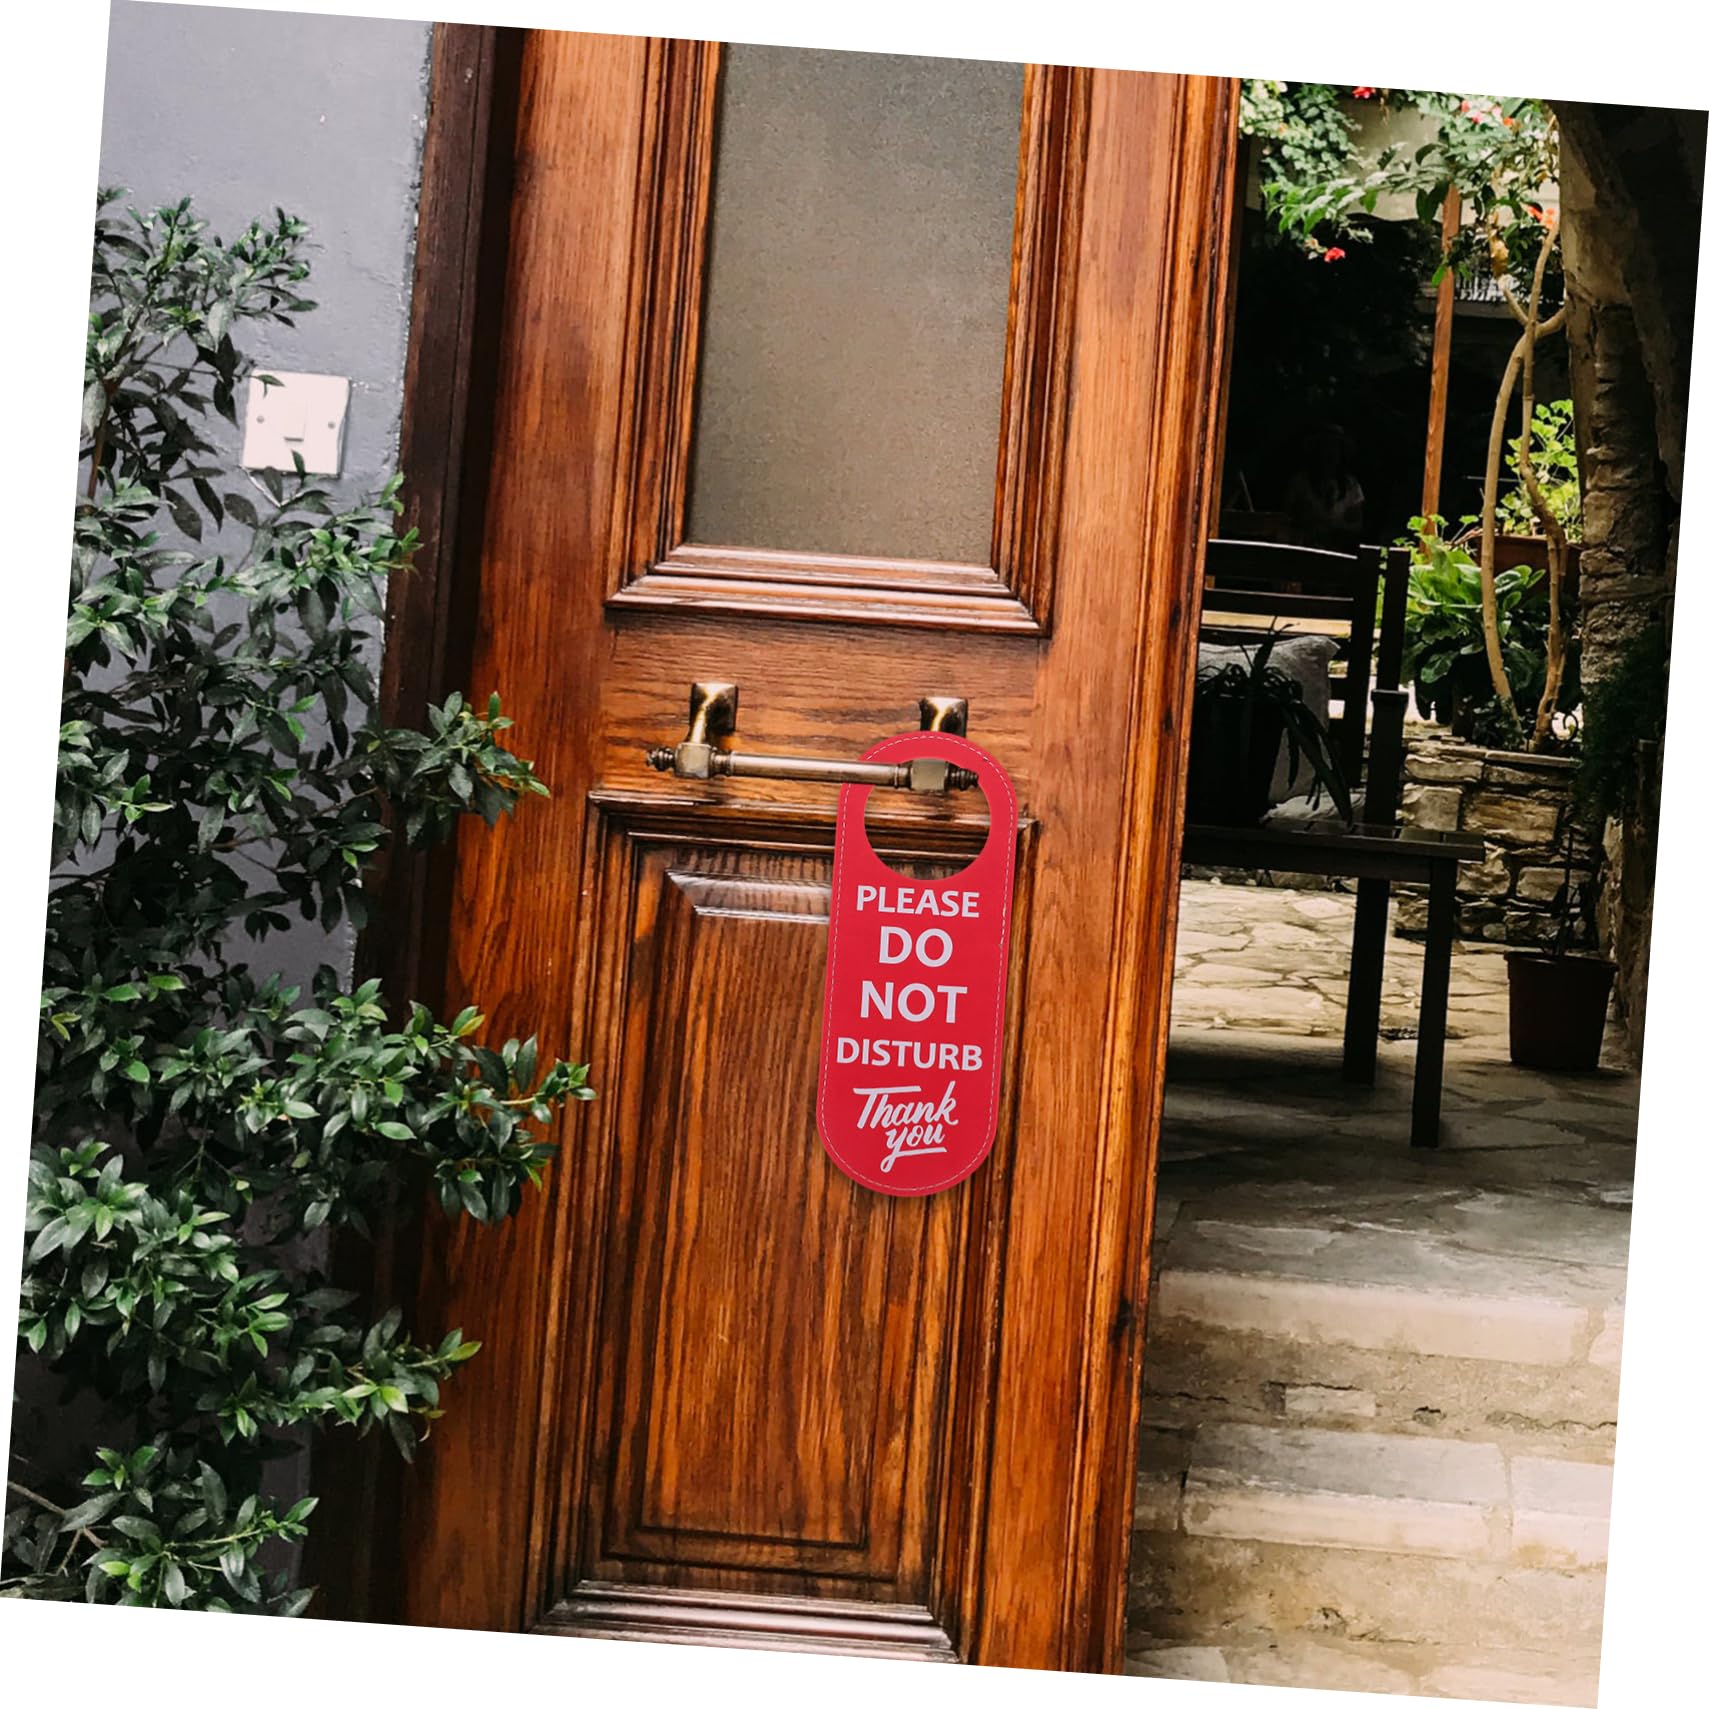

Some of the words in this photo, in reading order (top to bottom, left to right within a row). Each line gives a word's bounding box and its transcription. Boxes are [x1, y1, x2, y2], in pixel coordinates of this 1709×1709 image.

[856, 884, 980, 918] PLEASE
[878, 926, 953, 968] DO
[860, 981, 968, 1024] NOT
[836, 1037, 983, 1071] DISTURB
[853, 1080, 959, 1129] Thank
[880, 1123, 948, 1173] you
